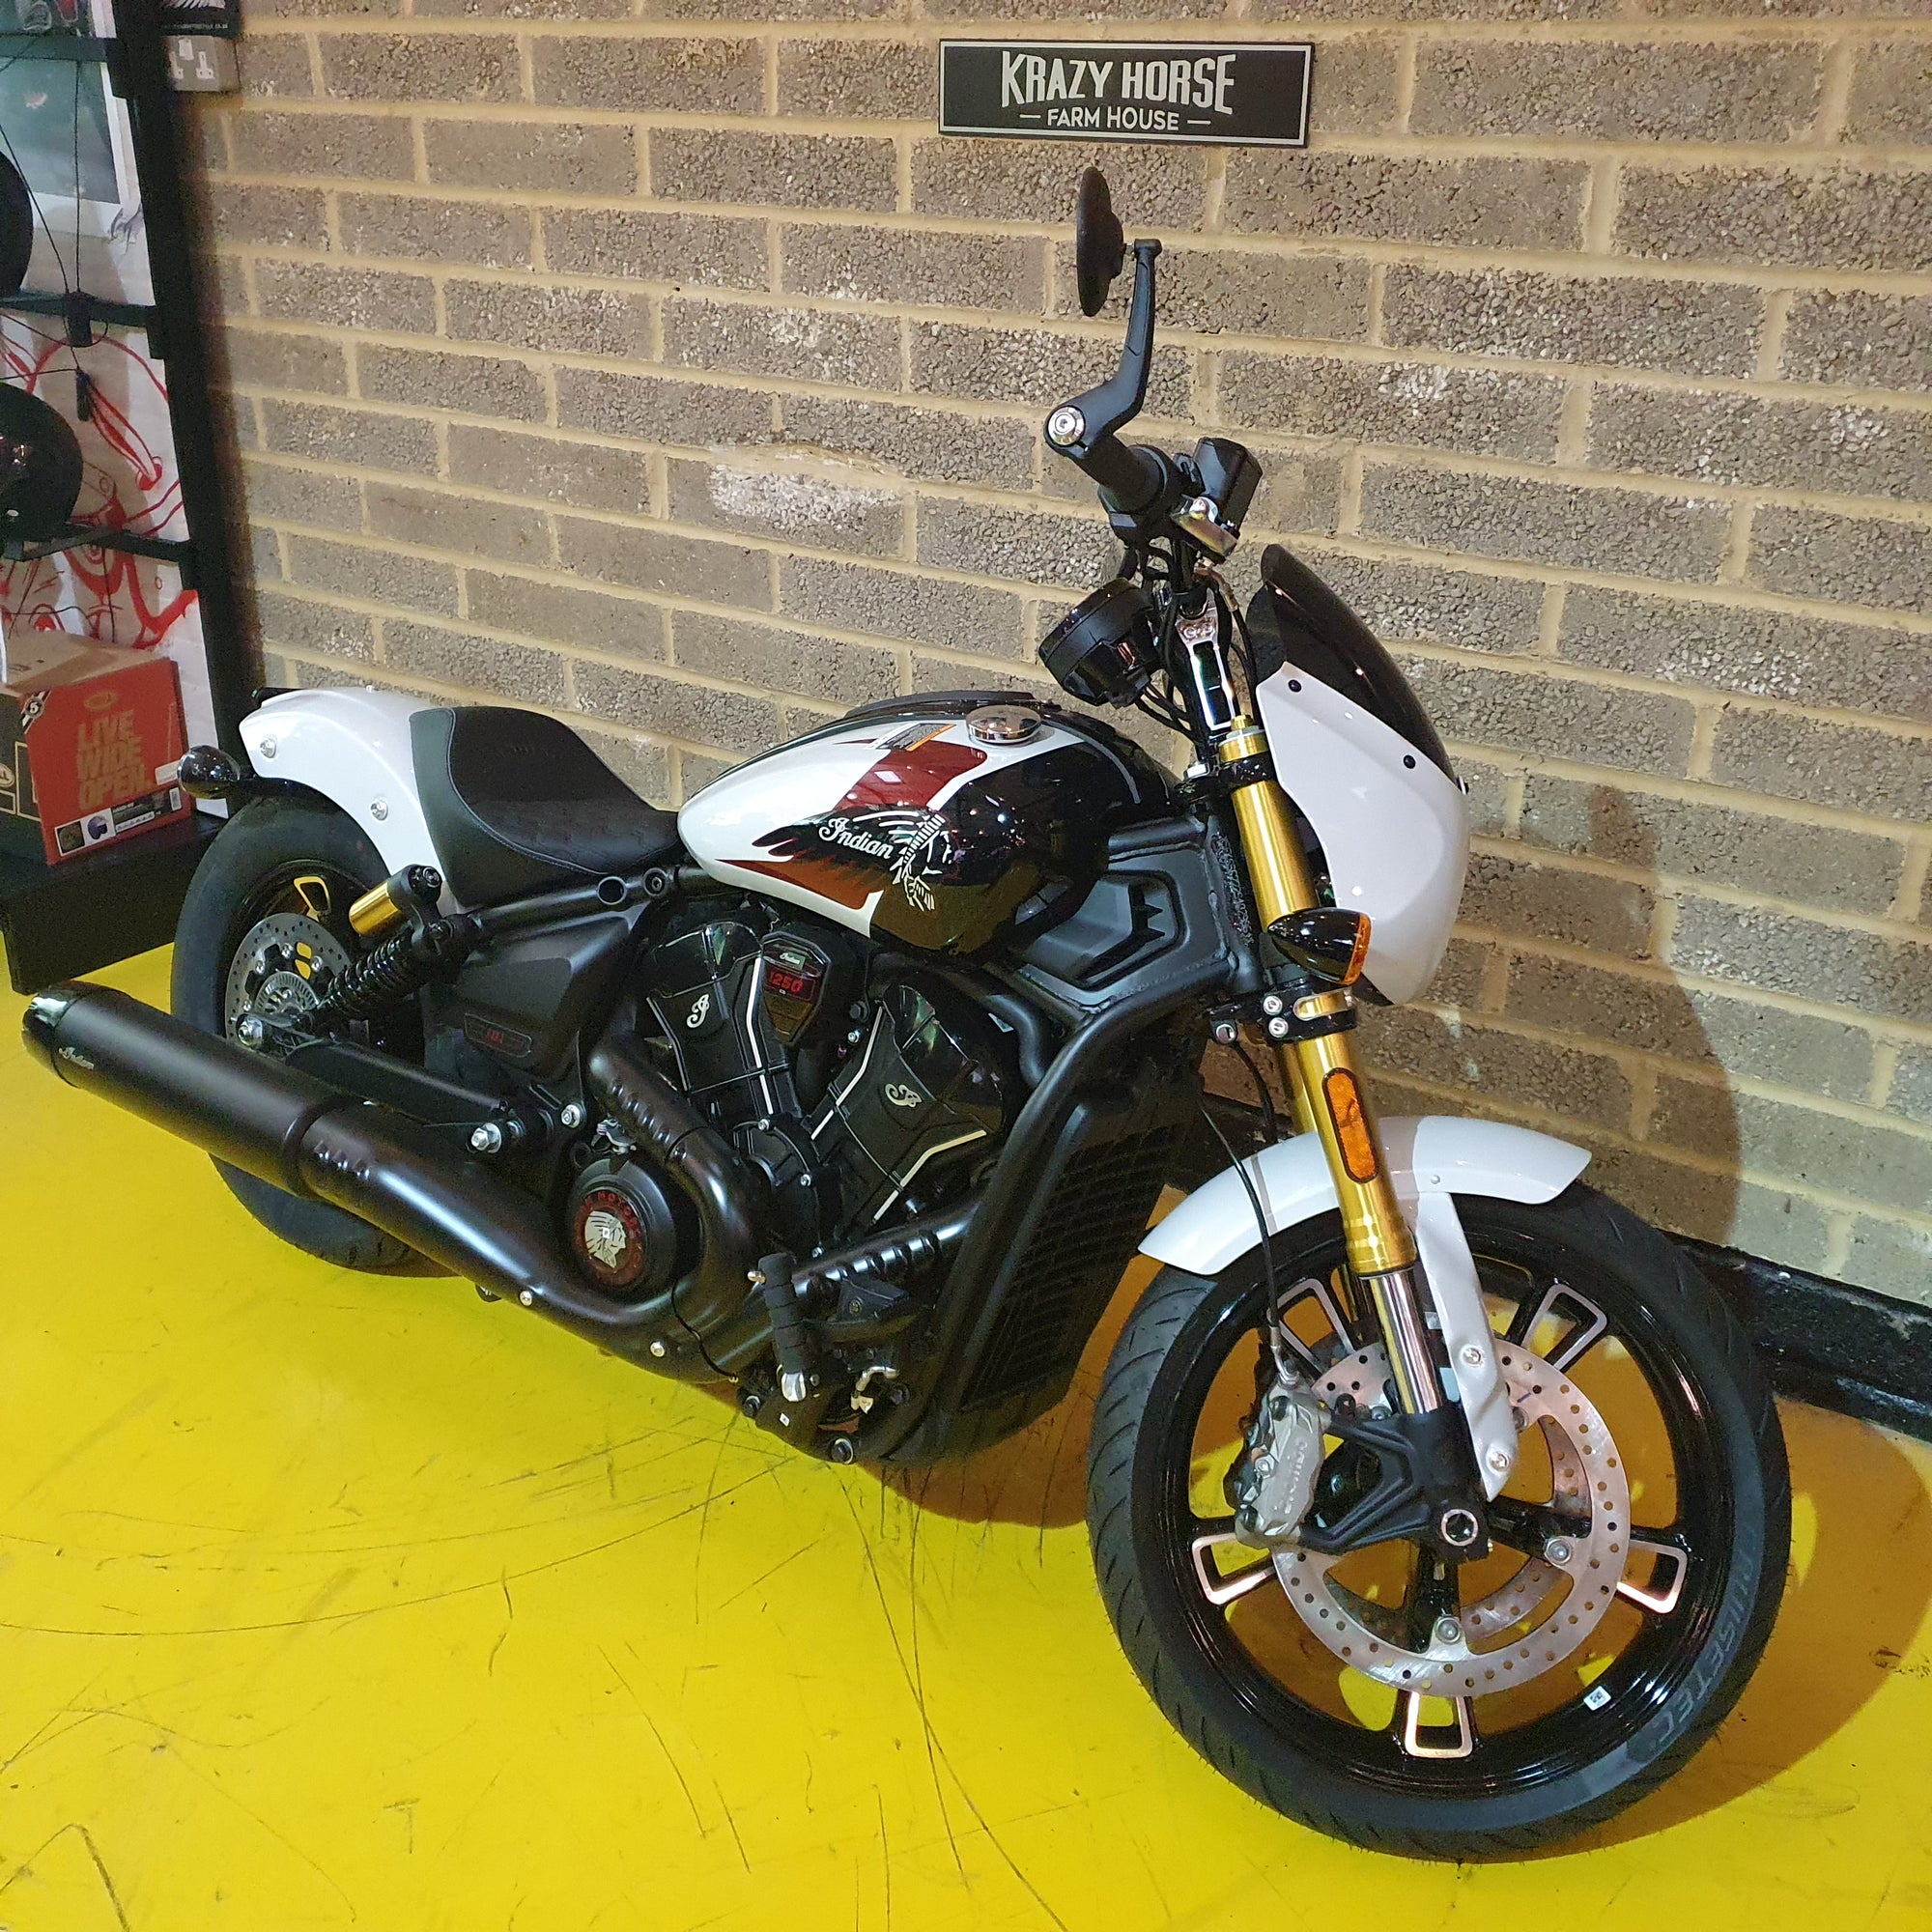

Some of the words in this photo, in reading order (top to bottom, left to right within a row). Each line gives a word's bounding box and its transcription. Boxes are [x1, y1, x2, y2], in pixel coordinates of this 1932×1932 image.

[1001, 50, 1114, 108] KRAZY
[1121, 53, 1236, 115] HORSE
[1047, 107, 1100, 128] FARM
[1106, 107, 1179, 130] HOUSE
[77, 710, 134, 747] LIVE
[818, 816, 895, 860] Indian
